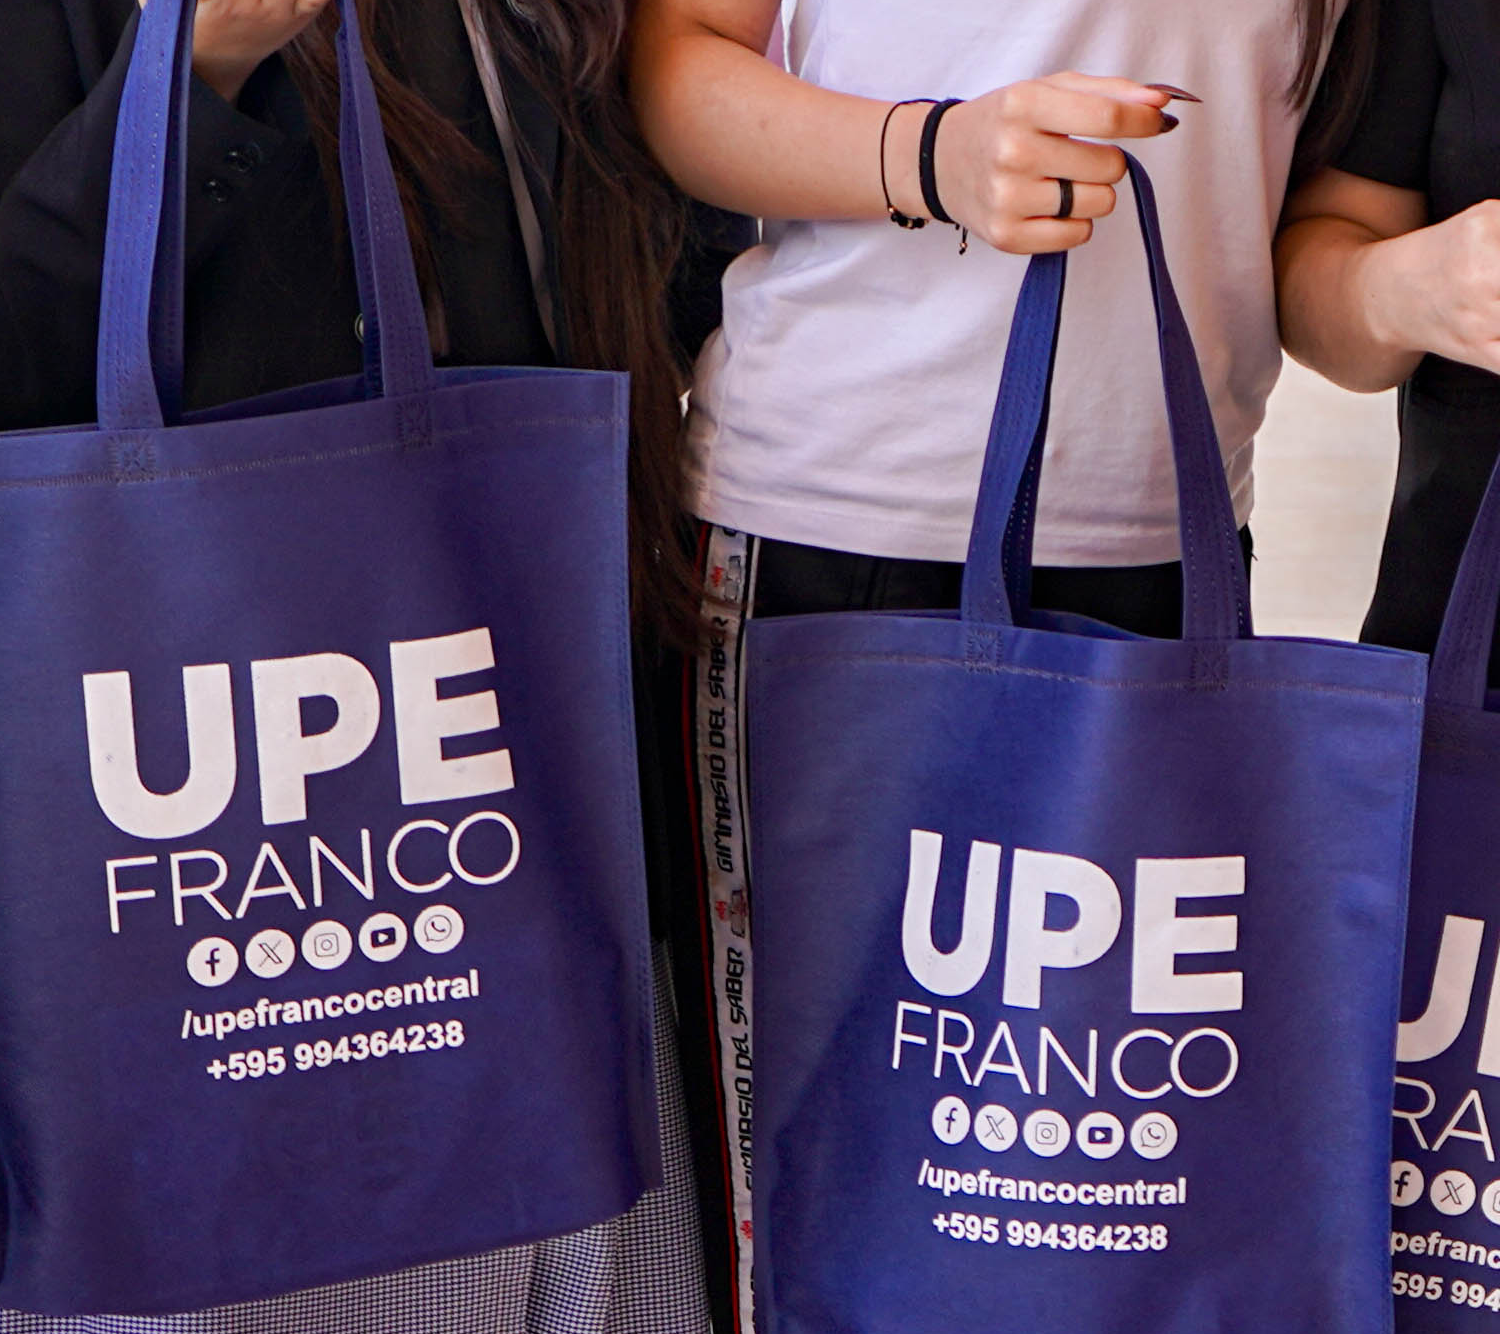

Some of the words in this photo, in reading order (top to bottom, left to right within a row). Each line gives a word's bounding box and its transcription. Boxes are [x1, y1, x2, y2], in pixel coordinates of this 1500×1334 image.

[707, 615, 729, 700] SABER
[83, 626, 516, 840] UPE
[708, 706, 727, 747] DEL
[708, 753, 734, 874] GIMNASIO
[106, 811, 521, 933] FRANCO
[902, 828, 1246, 1014] UPE
[182, 969, 480, 1040] /upefrancocentral
[724, 947, 750, 1027] SABER
[206, 1046, 286, 1082] +595
[294, 1020, 465, 1073] 994364238
[732, 1032, 751, 1070] DEL
[892, 1000, 1239, 1100] FRANCO
[918, 1158, 1187, 1205] /upefrancocentral
[932, 1212, 999, 1244] +595
[1006, 1217, 1168, 1252] 994364238
[1392, 1272, 1443, 1301] 595
